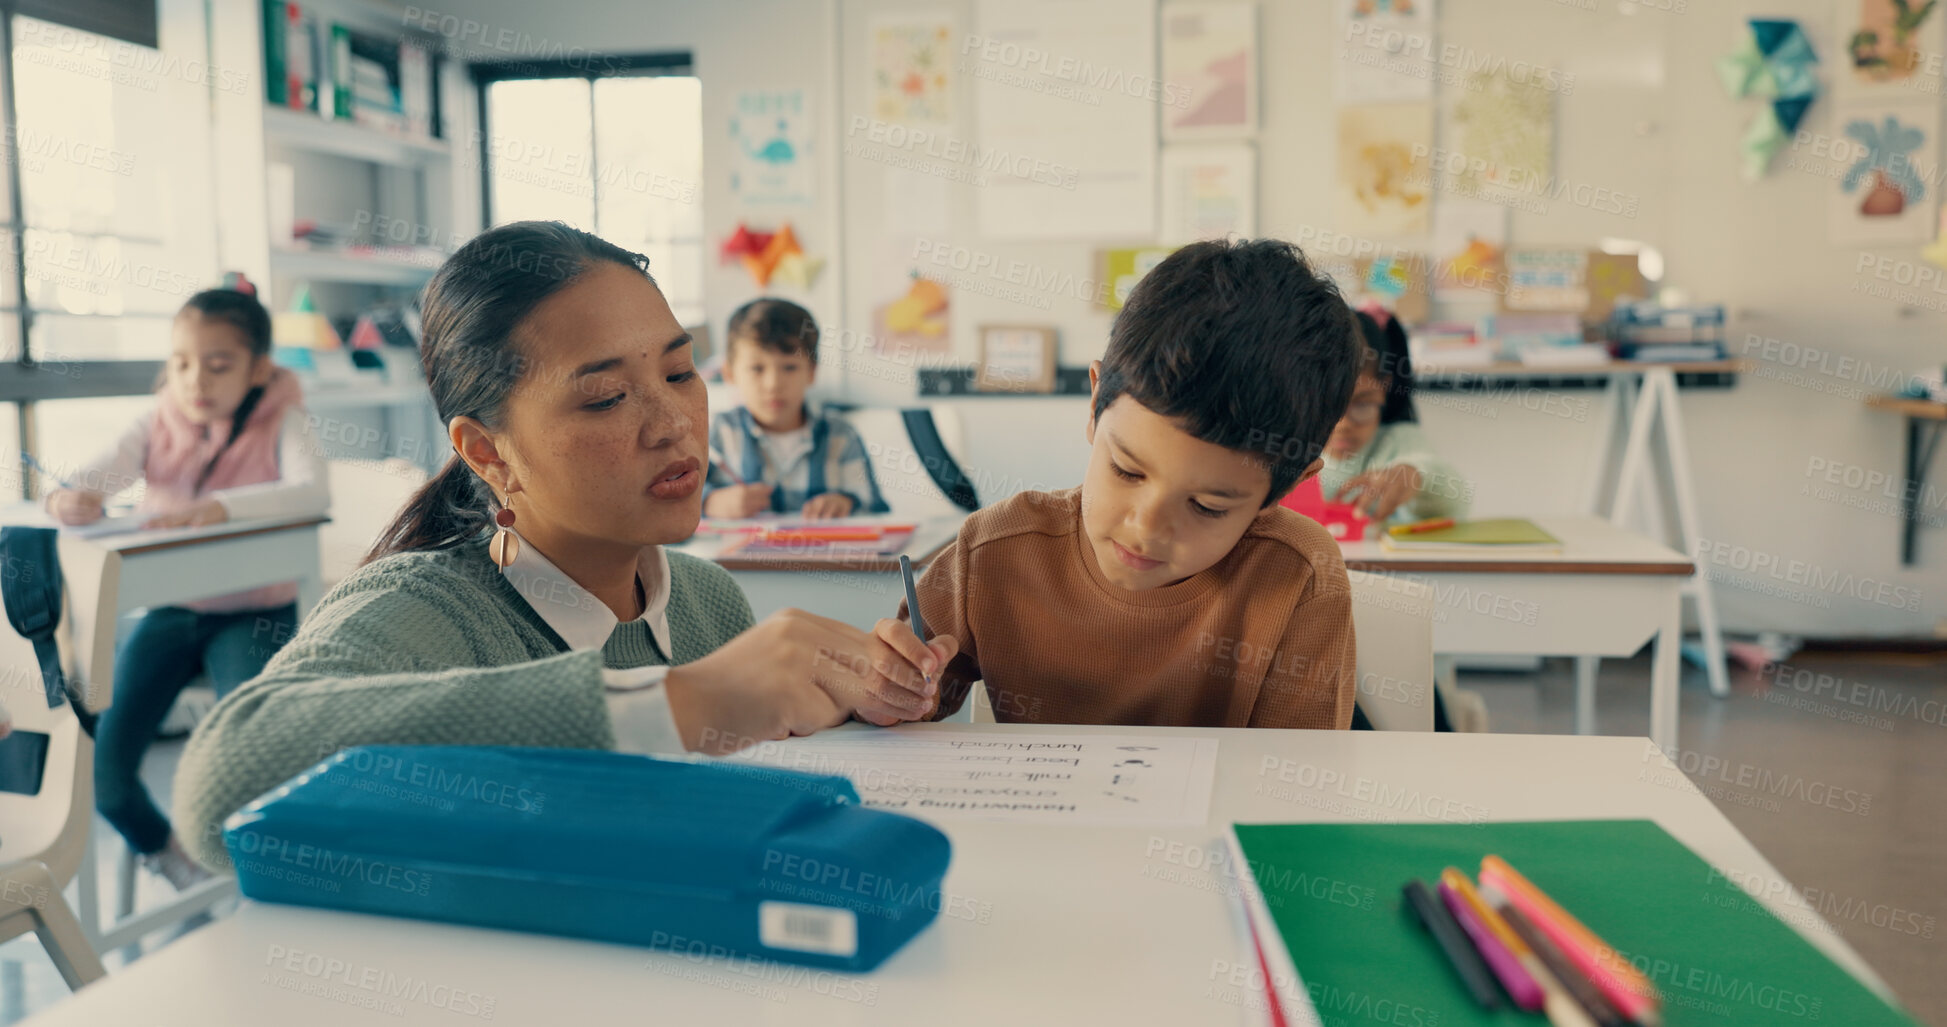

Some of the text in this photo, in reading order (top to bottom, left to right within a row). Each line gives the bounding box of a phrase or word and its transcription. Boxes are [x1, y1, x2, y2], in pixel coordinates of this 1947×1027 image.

[951, 741, 1082, 752] lunch lunch
[1026, 757, 1080, 767] bear
[1024, 772, 1072, 782] milk
[919, 800, 1076, 812] Handwriting
